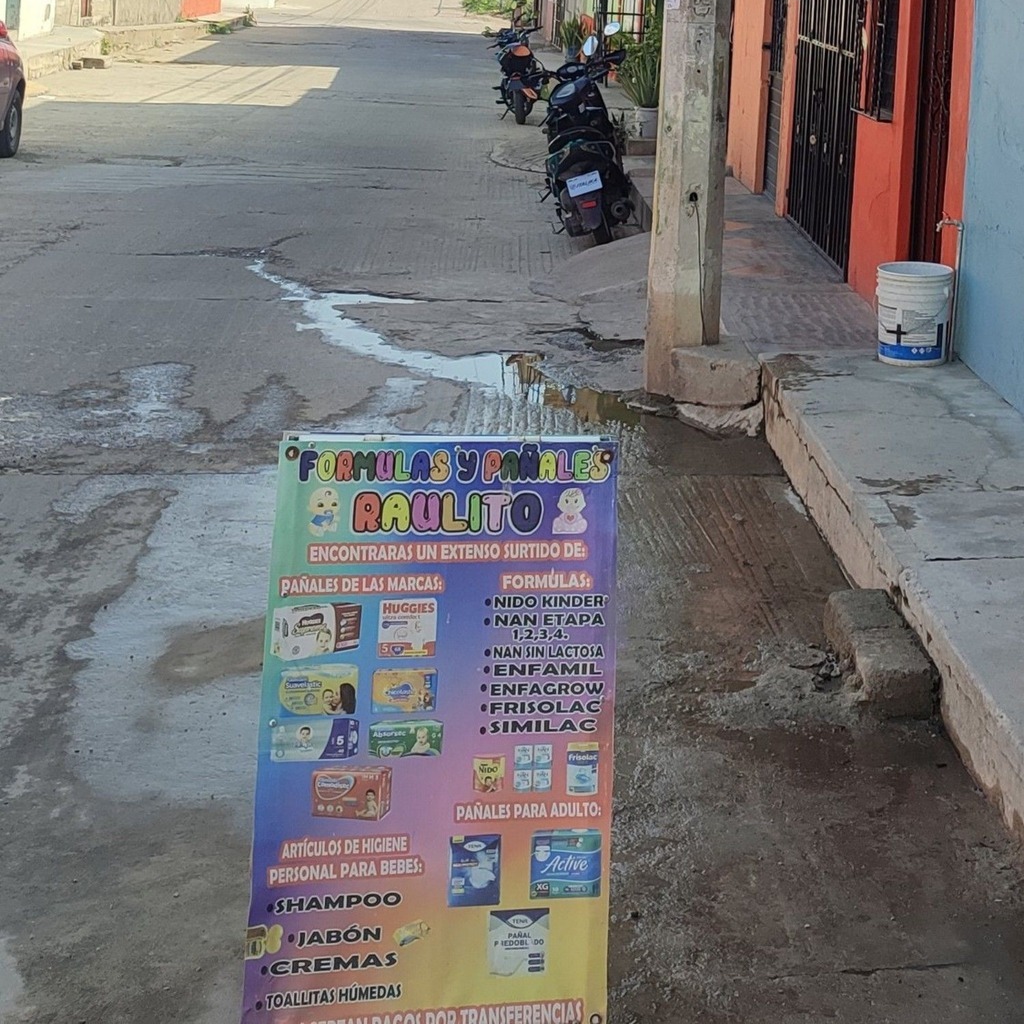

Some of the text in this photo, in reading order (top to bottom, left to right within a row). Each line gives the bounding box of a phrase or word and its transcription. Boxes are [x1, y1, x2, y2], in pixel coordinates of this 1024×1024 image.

[299, 443, 610, 482] FORMULAS Y PAÑALES
[353, 491, 543, 533] RAULITO
[309, 542, 586, 562] ENCONTRARAS UN EXTENSO SURTIDO DE:
[281, 576, 443, 594] PAÑALES DE LAS MARCAS:
[382, 603, 435, 614] HUGGIES
[494, 595, 605, 608] NIDO KINDER
[494, 613, 604, 626] NAN ETAPA
[512, 629, 569, 641] 1,2,3,4.
[381, 644, 389, 652] 5
[493, 645, 604, 658] NAN SIN LACTOSA
[494, 663, 602, 676] ENFAMIL
[490, 683, 604, 696] ENFAGROW
[490, 701, 601, 714] FRISOLAC
[490, 719, 596, 733] SIMILAC
[456, 802, 601, 821] PAÑALES PARA ADULTO:
[282, 836, 408, 859] ARTÍCULOS DE HIGIENE
[269, 858, 423, 885] PERSONAL PARA BEBES:
[541, 855, 589, 874] Active
[536, 883, 549, 891] XG
[275, 892, 402, 914] SHAMPOO
[298, 924, 382, 947] JABÓN
[494, 939, 544, 947] PEDOBLDO
[507, 931, 532, 939] PAÑAL
[270, 952, 398, 975] CREMAS
[266, 983, 402, 1009] TOALLITAS HÚMEDAS
[459, 1001, 582, 1024] TRANSFERENCIAS
